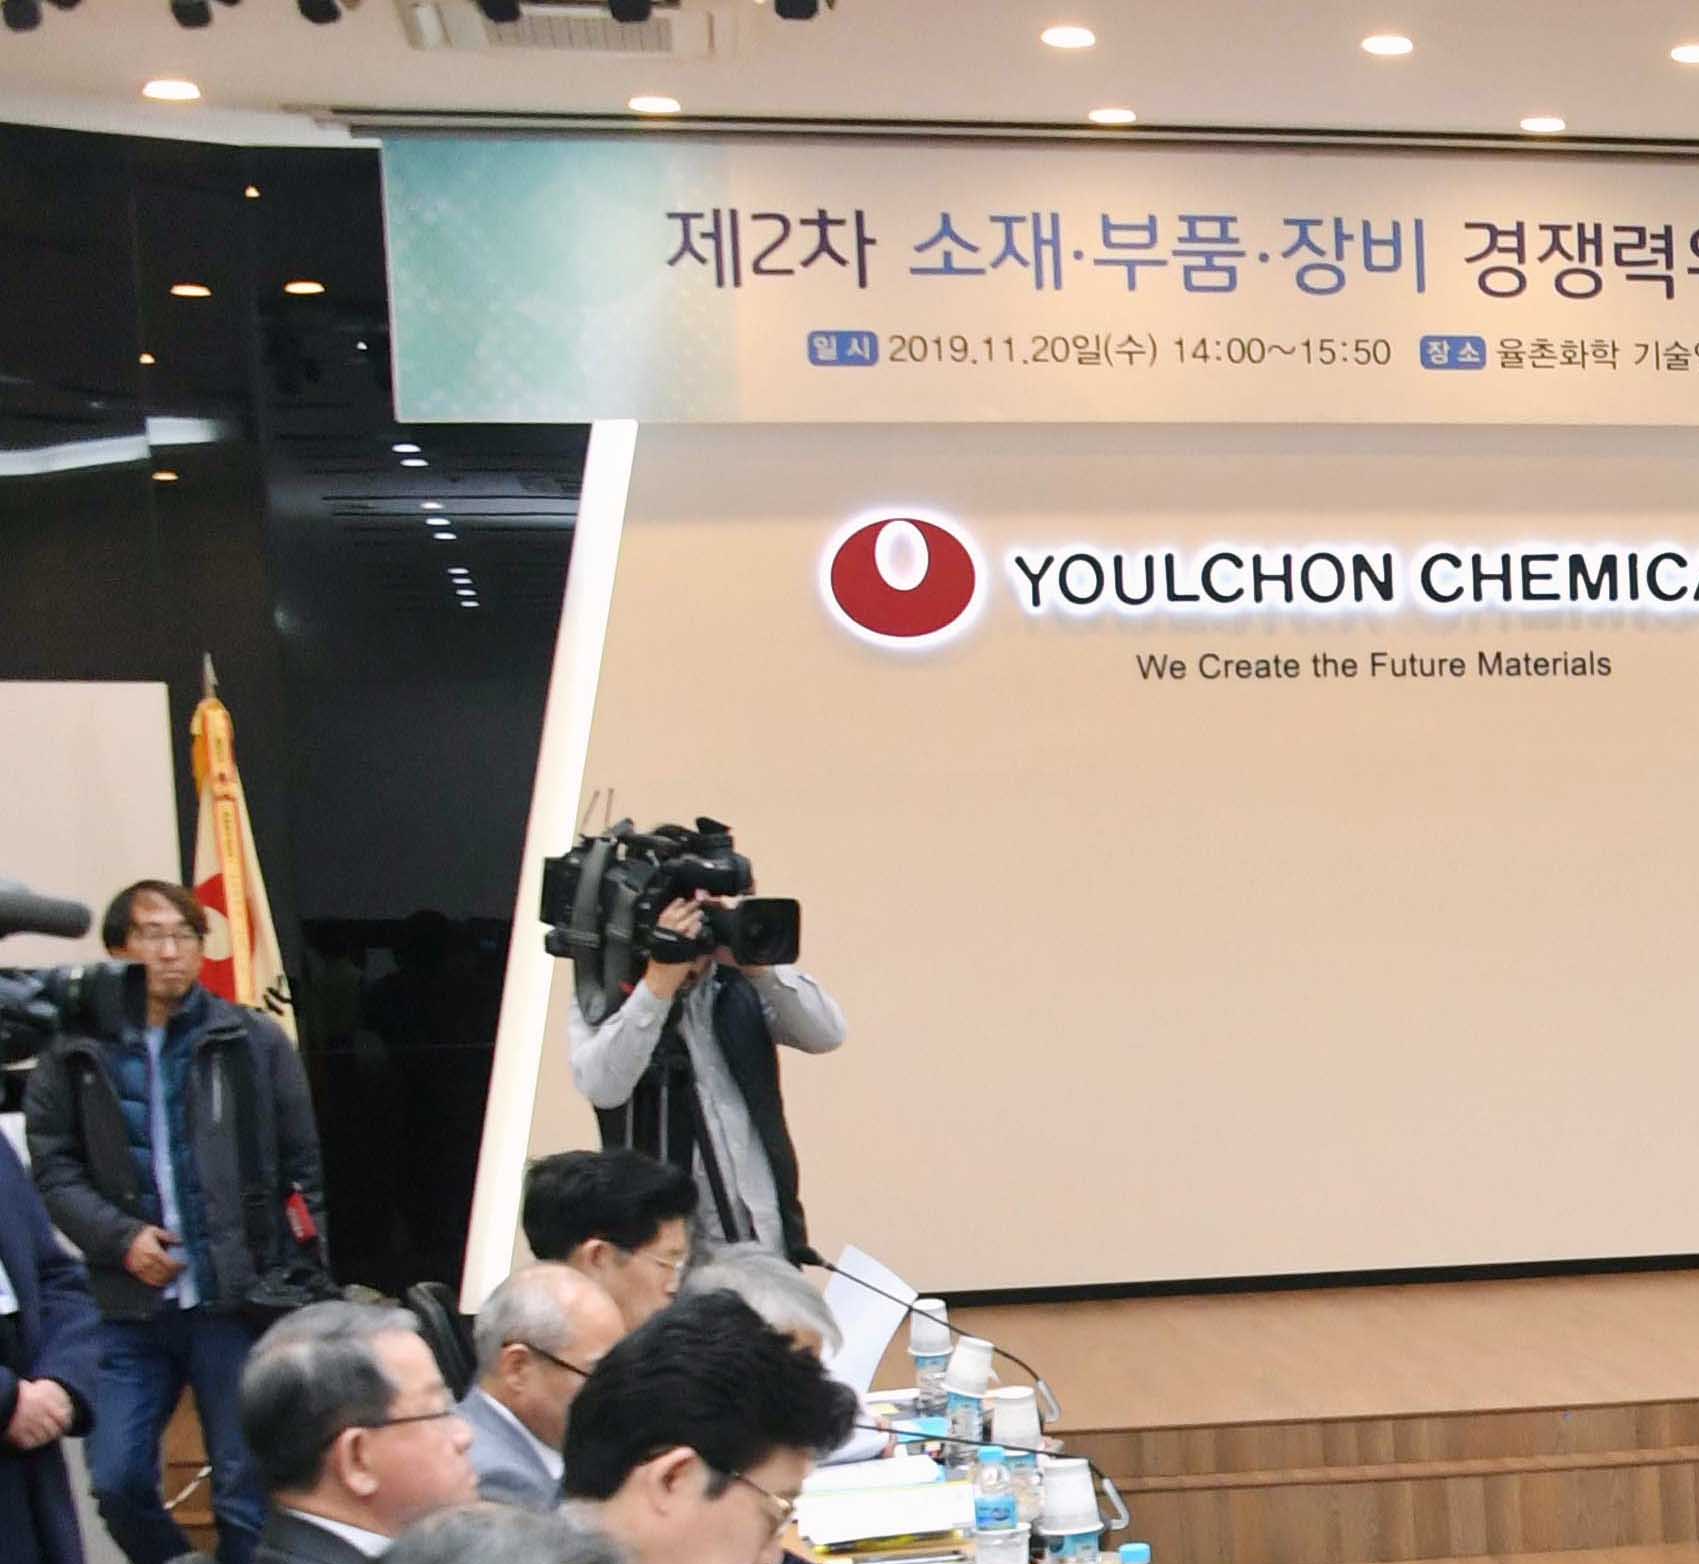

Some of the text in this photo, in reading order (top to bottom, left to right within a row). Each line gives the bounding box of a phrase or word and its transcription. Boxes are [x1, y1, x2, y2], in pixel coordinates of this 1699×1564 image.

[666, 207, 877, 290] 제2차
[888, 334, 1158, 367] 2019.11.20일(수)
[1174, 336, 1392, 367] 14:00~15:50
[1495, 338, 1620, 371] 율촌화학
[1014, 552, 1394, 608] YOULCHON
[1136, 650, 1613, 681] We Create the Future Materials
